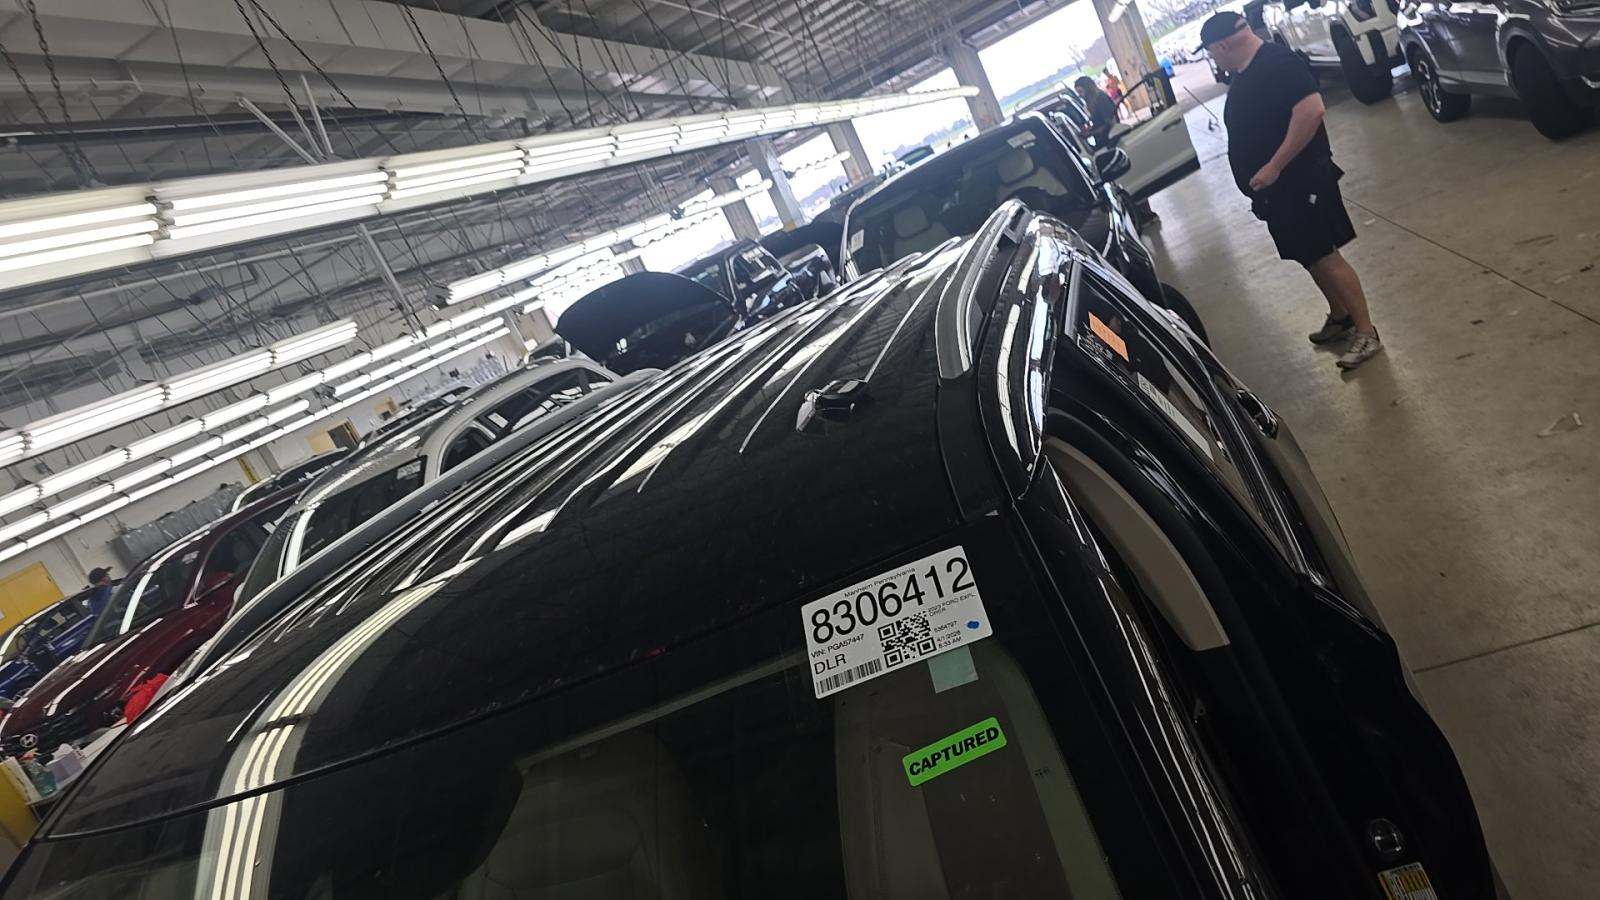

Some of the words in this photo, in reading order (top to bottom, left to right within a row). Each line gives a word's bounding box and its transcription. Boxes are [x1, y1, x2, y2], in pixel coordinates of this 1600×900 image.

[811, 557, 975, 644] 8306412
[810, 646, 826, 659] VIN:
[814, 653, 847, 675] DLR
[908, 726, 1000, 776] CAPTURED
